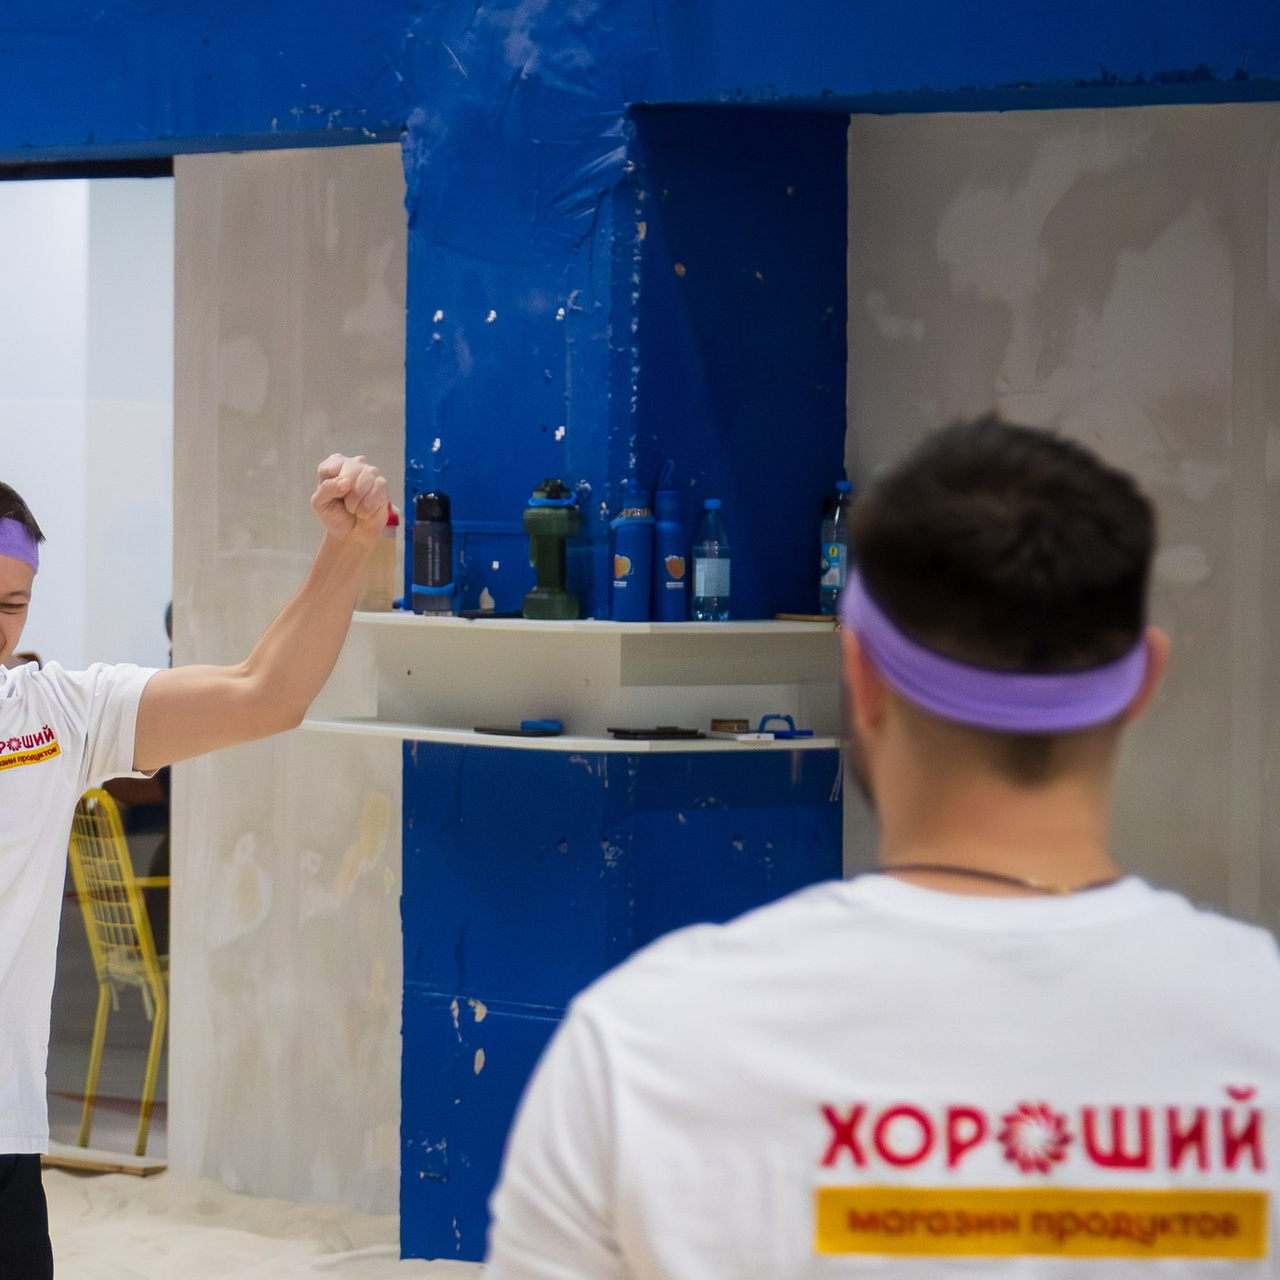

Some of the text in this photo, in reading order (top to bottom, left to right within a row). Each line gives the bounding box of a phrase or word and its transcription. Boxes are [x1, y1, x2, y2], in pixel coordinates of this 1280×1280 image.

[820, 1086, 1266, 1174] ХОРОШИЙ
[848, 1208, 1240, 1247] магазин продуктов
